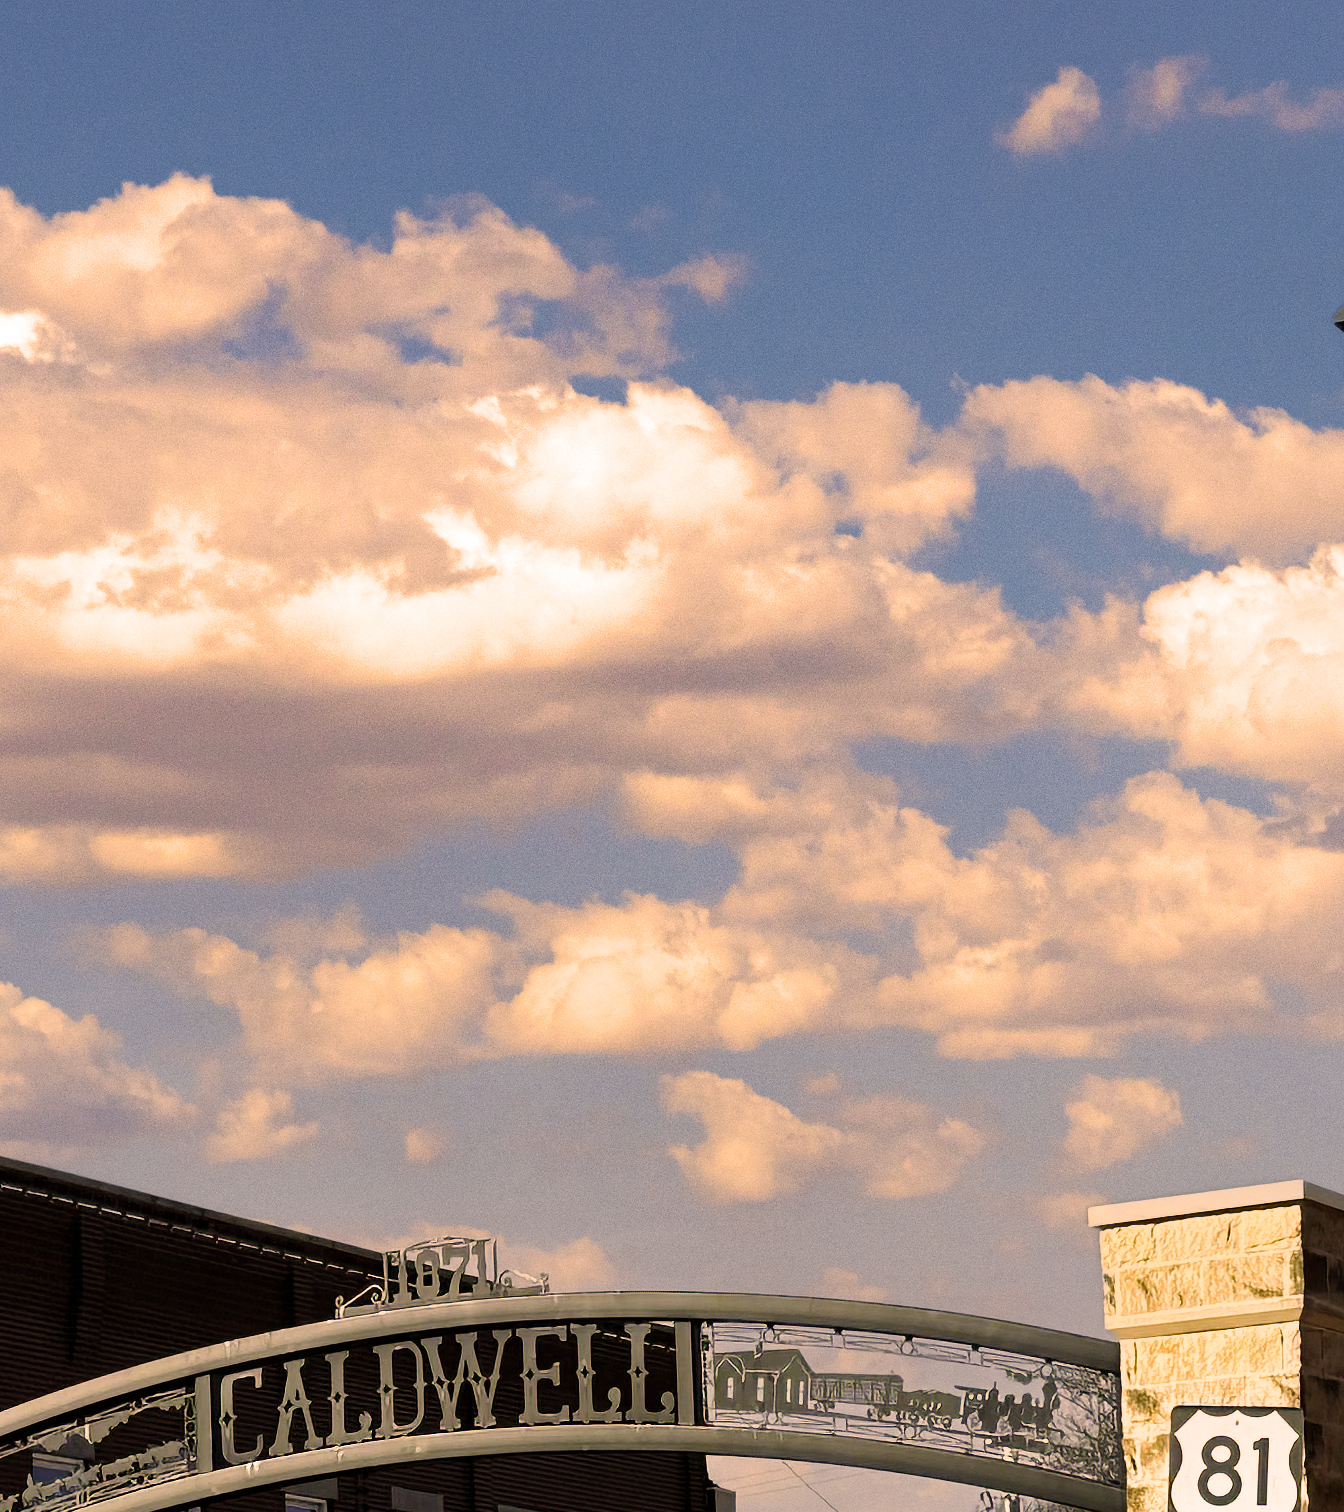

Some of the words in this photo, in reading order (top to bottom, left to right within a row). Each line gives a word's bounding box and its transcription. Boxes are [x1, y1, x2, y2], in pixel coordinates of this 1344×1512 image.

[392, 1240, 494, 1305] 1871
[219, 1322, 677, 1465] CALDWELL
[1197, 1434, 1269, 1506] 81
